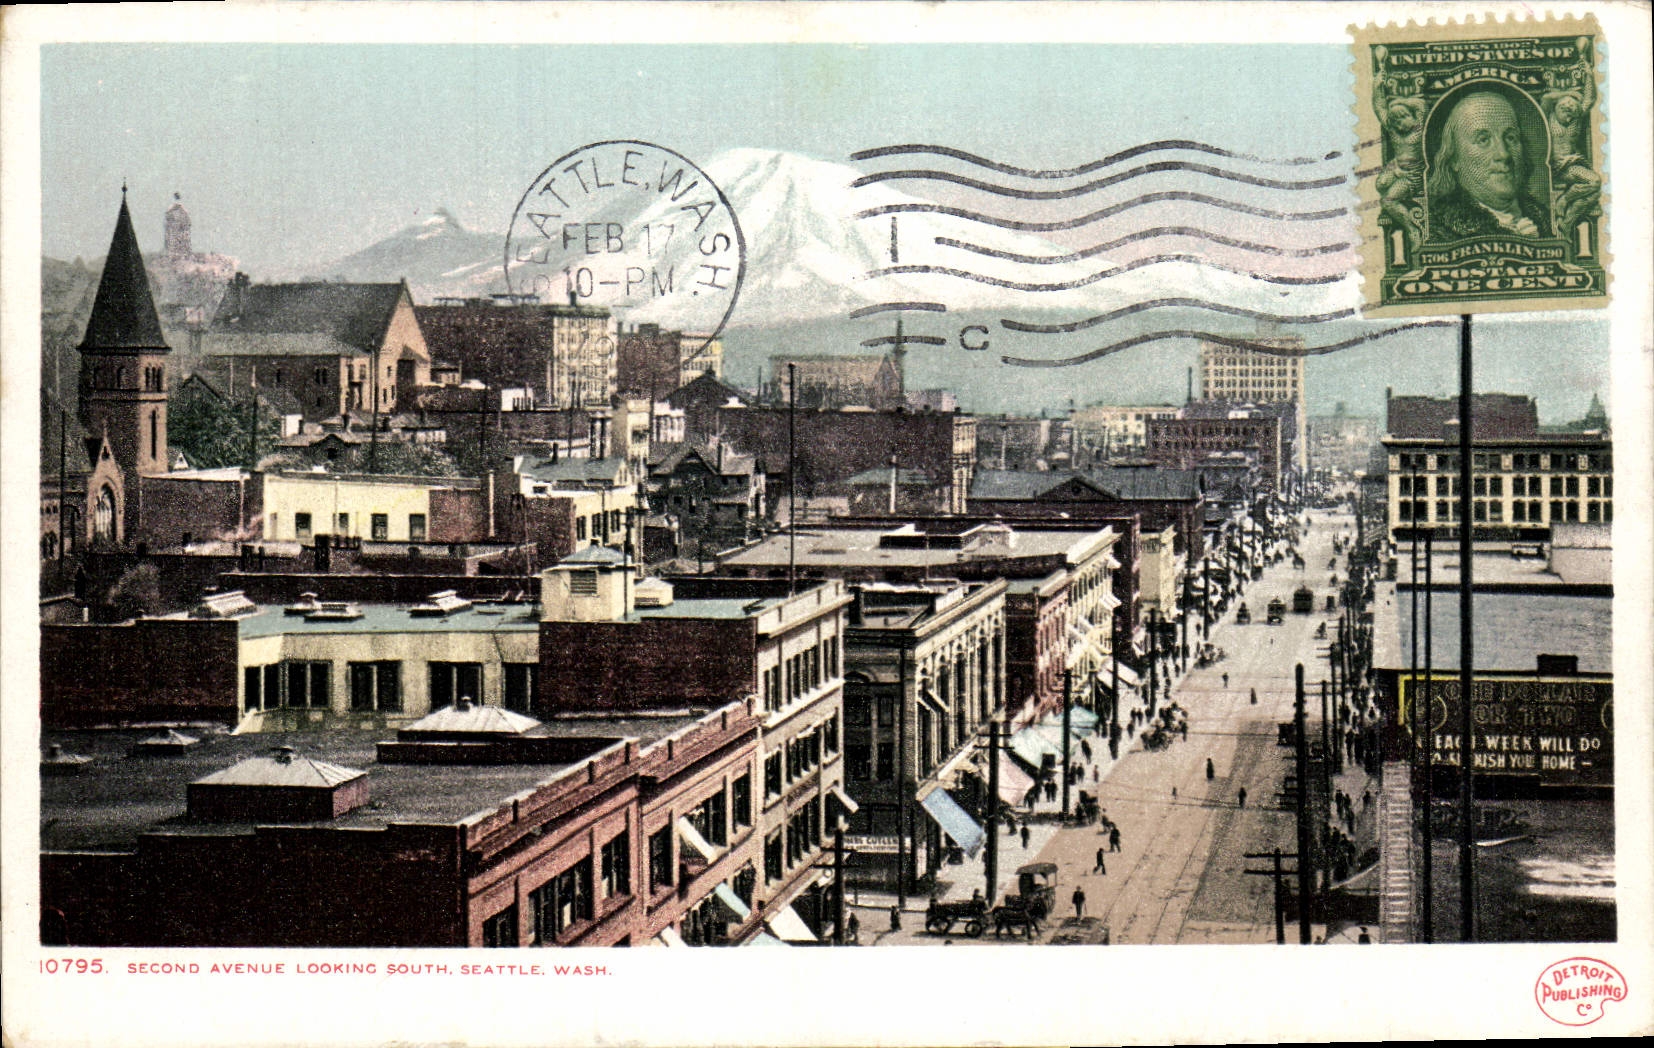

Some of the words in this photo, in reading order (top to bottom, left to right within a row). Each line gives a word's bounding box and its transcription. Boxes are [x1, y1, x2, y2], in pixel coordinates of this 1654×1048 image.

[1390, 52, 1464, 66] UNITED
[1467, 48, 1545, 62] STATES
[1547, 47, 1575, 59] OF
[1431, 67, 1540, 89] AMERICA
[563, 223, 624, 254] FEB
[642, 224, 675, 254] 17
[659, 161, 731, 296] WASH.
[1576, 221, 1593, 258] 1
[1391, 230, 1407, 266] 1
[1421, 252, 1449, 264] 1706
[1451, 242, 1534, 261] FRANKLIN
[1536, 247, 1563, 259] 1790
[1430, 265, 1554, 281] POSTAGE
[1403, 279, 1481, 294] ONE
[1485, 275, 1584, 290] CENT
[959, 325, 989, 351] C
[1486, 735, 1533, 751] WEEK
[1540, 737, 1573, 753] WILL
[1580, 738, 1601, 752] DO
[1542, 755, 1577, 771] HOME
